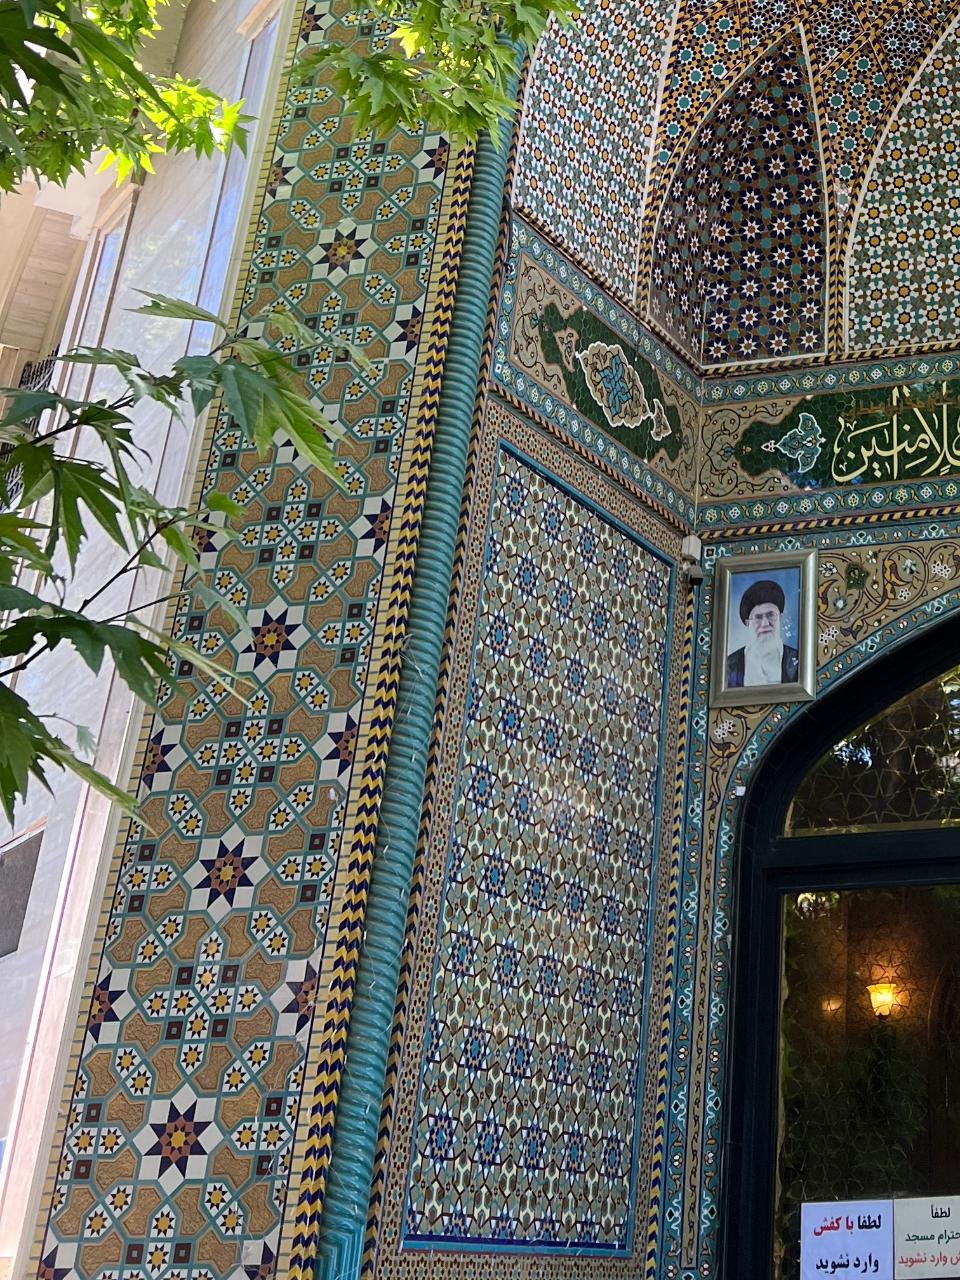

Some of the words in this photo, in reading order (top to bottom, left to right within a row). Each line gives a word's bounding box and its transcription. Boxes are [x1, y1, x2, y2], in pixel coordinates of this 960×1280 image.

[814, 1216, 842, 1236] کفش
[846, 1216, 854, 1235] با
[857, 1213, 881, 1230] لطفا
[905, 1233, 935, 1244] مسجد
[816, 1253, 850, 1274] نشوید
[853, 1253, 879, 1273] وارد
[898, 1253, 926, 1268] نشوید
[930, 1252, 947, 1267] وارد
